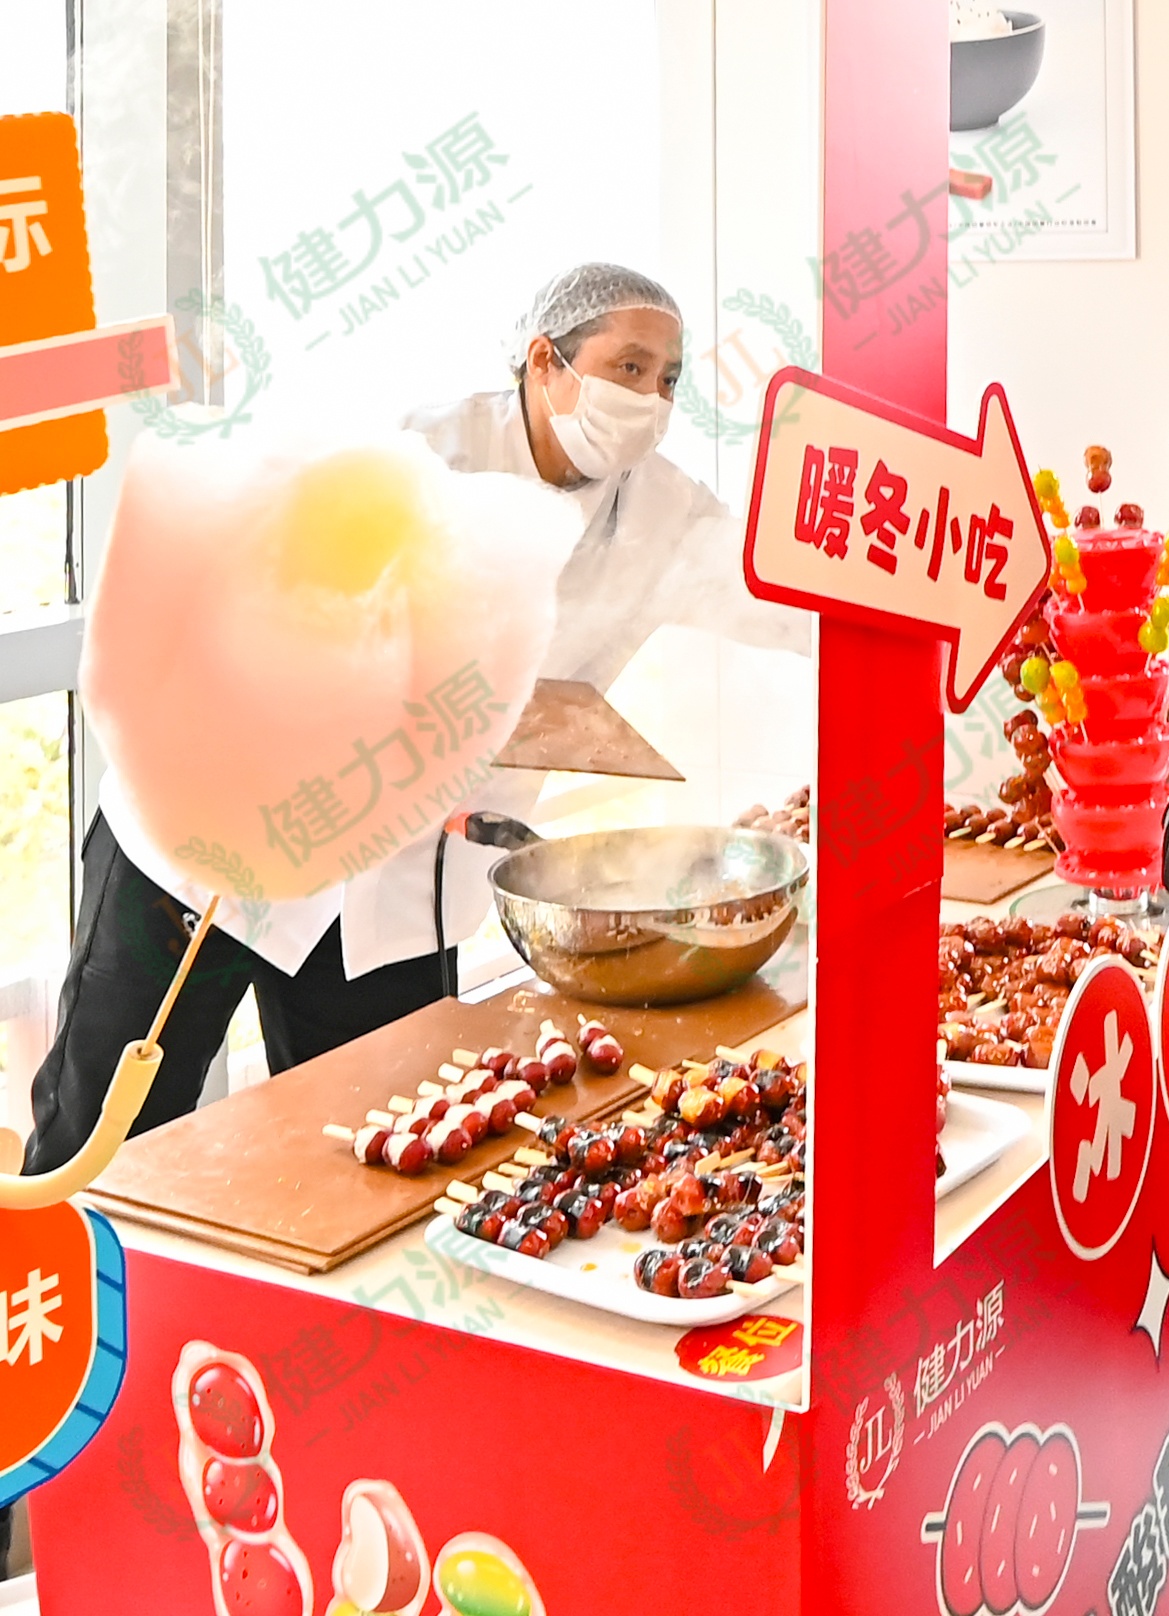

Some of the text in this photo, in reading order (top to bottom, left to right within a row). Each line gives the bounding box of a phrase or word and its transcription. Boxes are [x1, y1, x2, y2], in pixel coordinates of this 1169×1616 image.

[794, 444, 1014, 602] 暖冬小吃
[1069, 1009, 1137, 1204] 冰
[913, 1278, 1005, 1419] 健力源
[926, 1395, 954, 1439] JIAN
[966, 1352, 994, 1397] YUAN
[859, 1405, 893, 1475] JL
